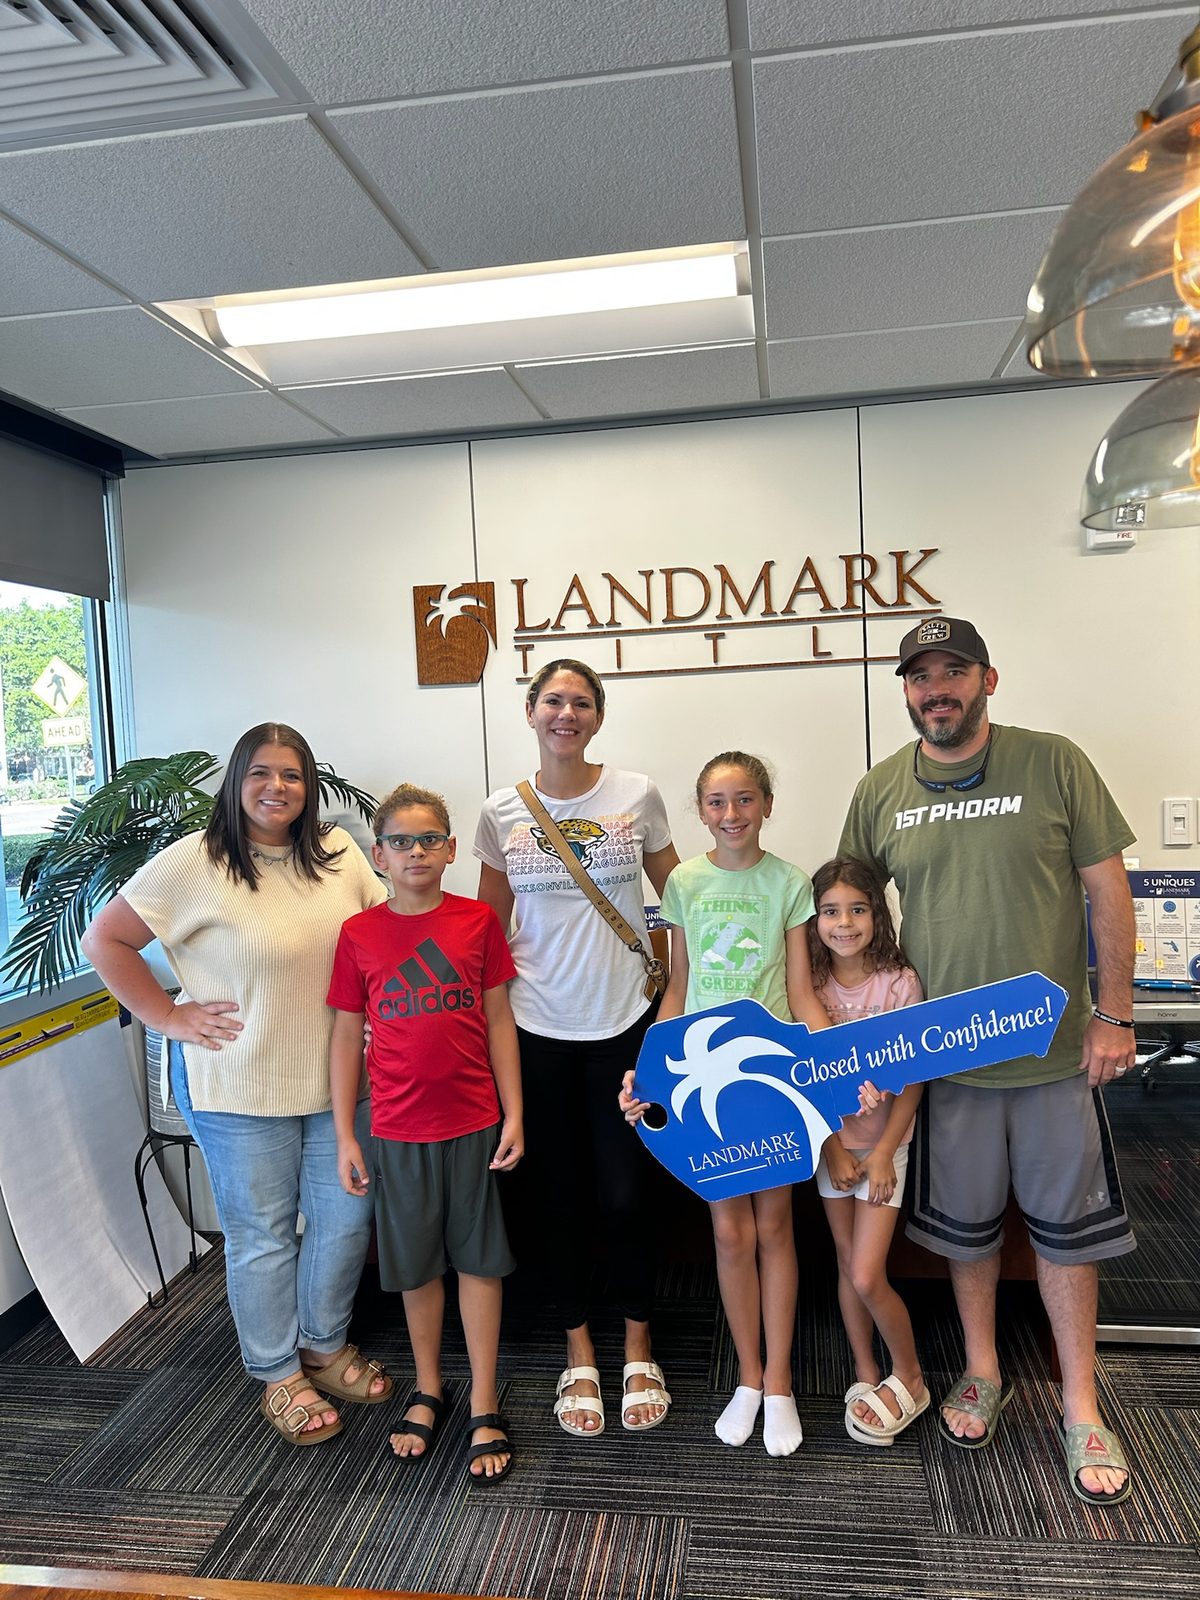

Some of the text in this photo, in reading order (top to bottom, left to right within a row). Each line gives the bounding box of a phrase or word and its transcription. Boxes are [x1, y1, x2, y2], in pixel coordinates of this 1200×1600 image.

[510, 548, 941, 631] LANDMARK
[922, 632, 945, 641] CREW
[514, 619, 929, 675] TITL
[47, 724, 82, 738] AHEAD
[895, 795, 1023, 831] 1ST PHORM
[592, 846, 636, 860] AGUARS
[592, 871, 638, 887] AGUARS
[1143, 878, 1196, 888] 5 UNIQUES
[701, 900, 761, 913] THINK
[701, 976, 758, 991] GREEN
[378, 985, 475, 1020] adidas
[790, 996, 1054, 1087] Closed with Confidence!
[688, 1131, 800, 1173] LANDMARK
[765, 1149, 802, 1167] TITLE
